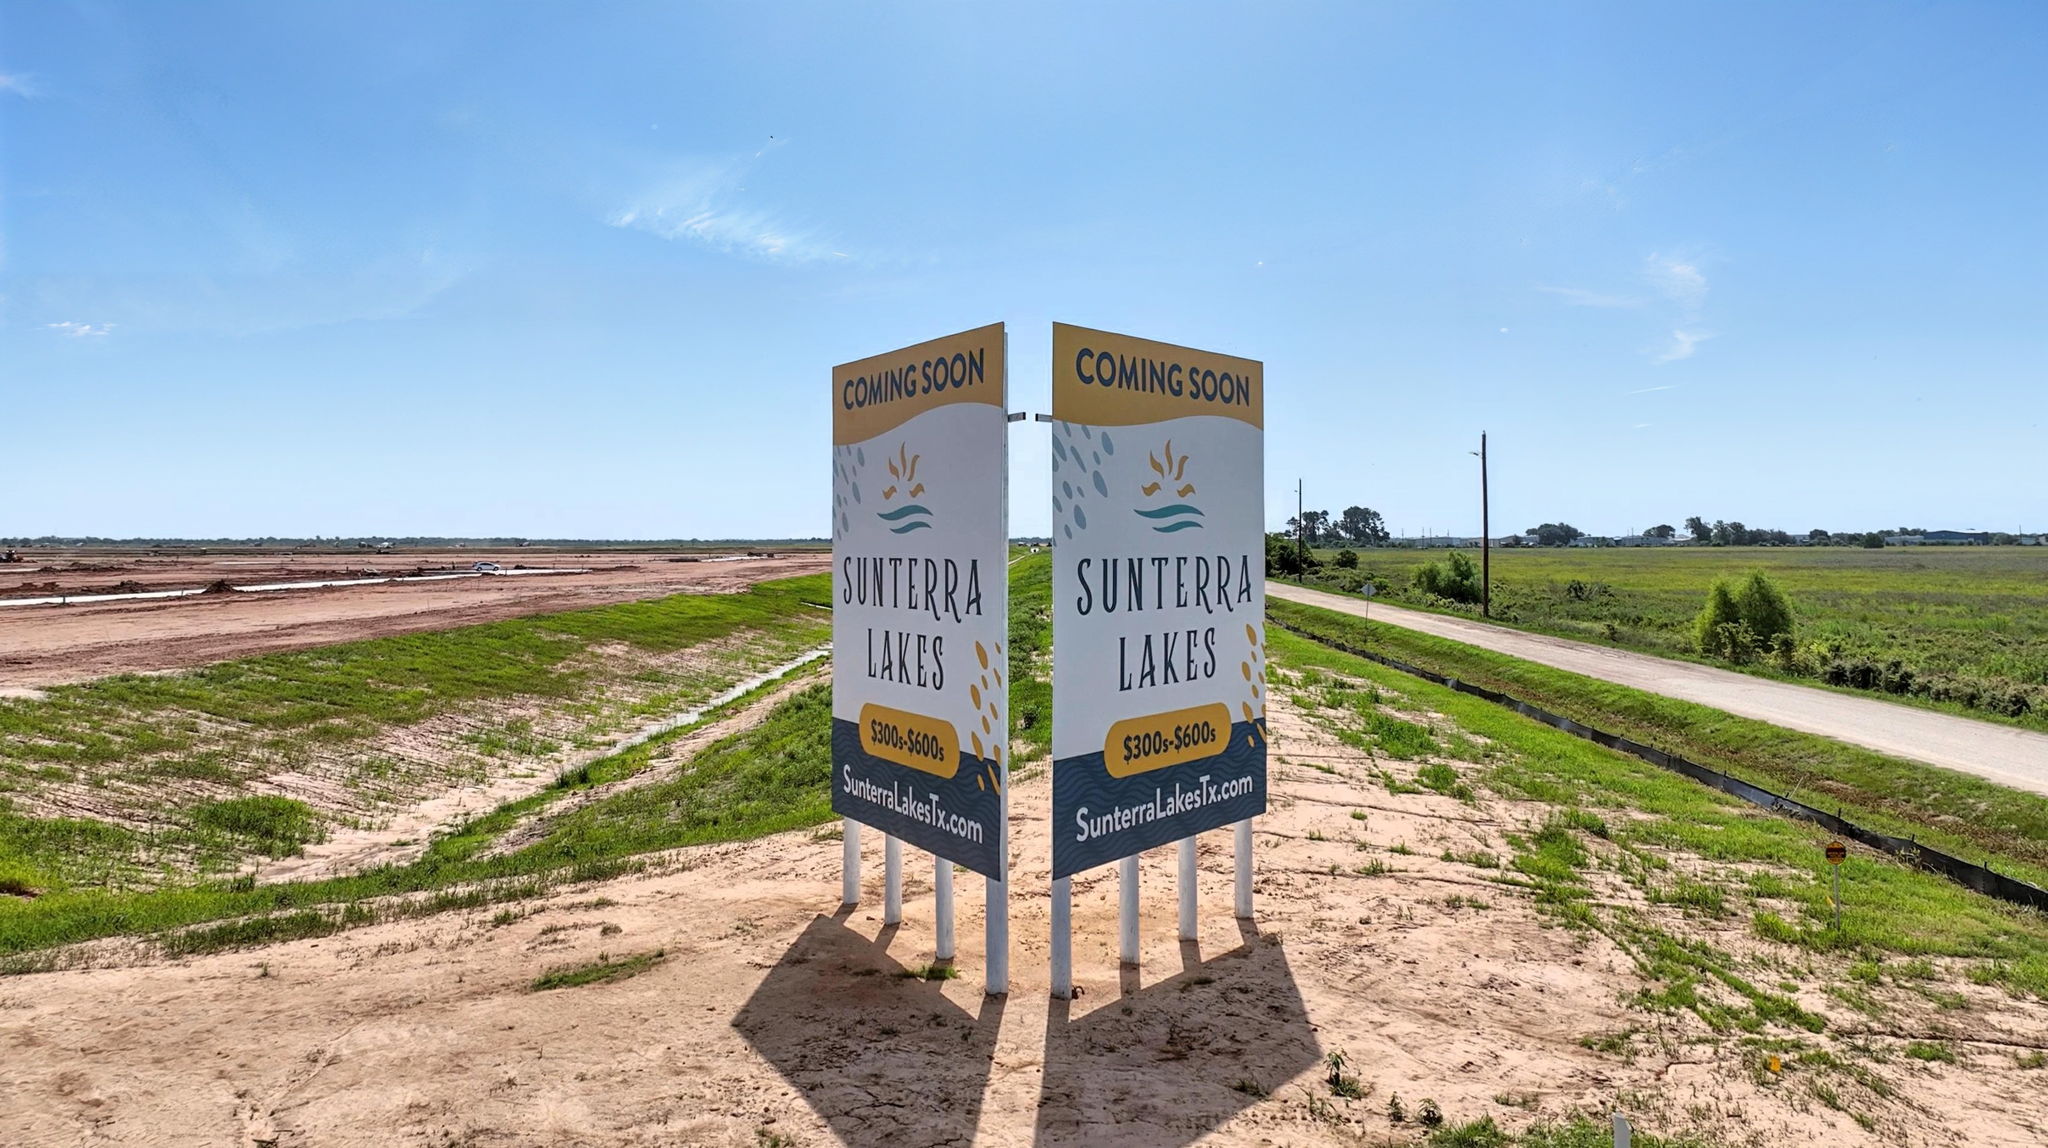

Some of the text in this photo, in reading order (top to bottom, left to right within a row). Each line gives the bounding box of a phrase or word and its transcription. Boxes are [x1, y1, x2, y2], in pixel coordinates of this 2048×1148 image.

[843, 348, 985, 410] COMING SOON
[1076, 347, 1250, 407] COMING SOON
[843, 556, 982, 623] SUNTERRA
[1076, 555, 1252, 616] SUNTERRA
[867, 628, 944, 691] LAKES
[1119, 627, 1216, 692] LAKES
[871, 719, 945, 763] $300s-$600s
[1123, 721, 1216, 765] $300s-$600s
[843, 764, 983, 844] SunterraLakesTx.com
[1076, 774, 1253, 842] SunterraLakesTx.com
